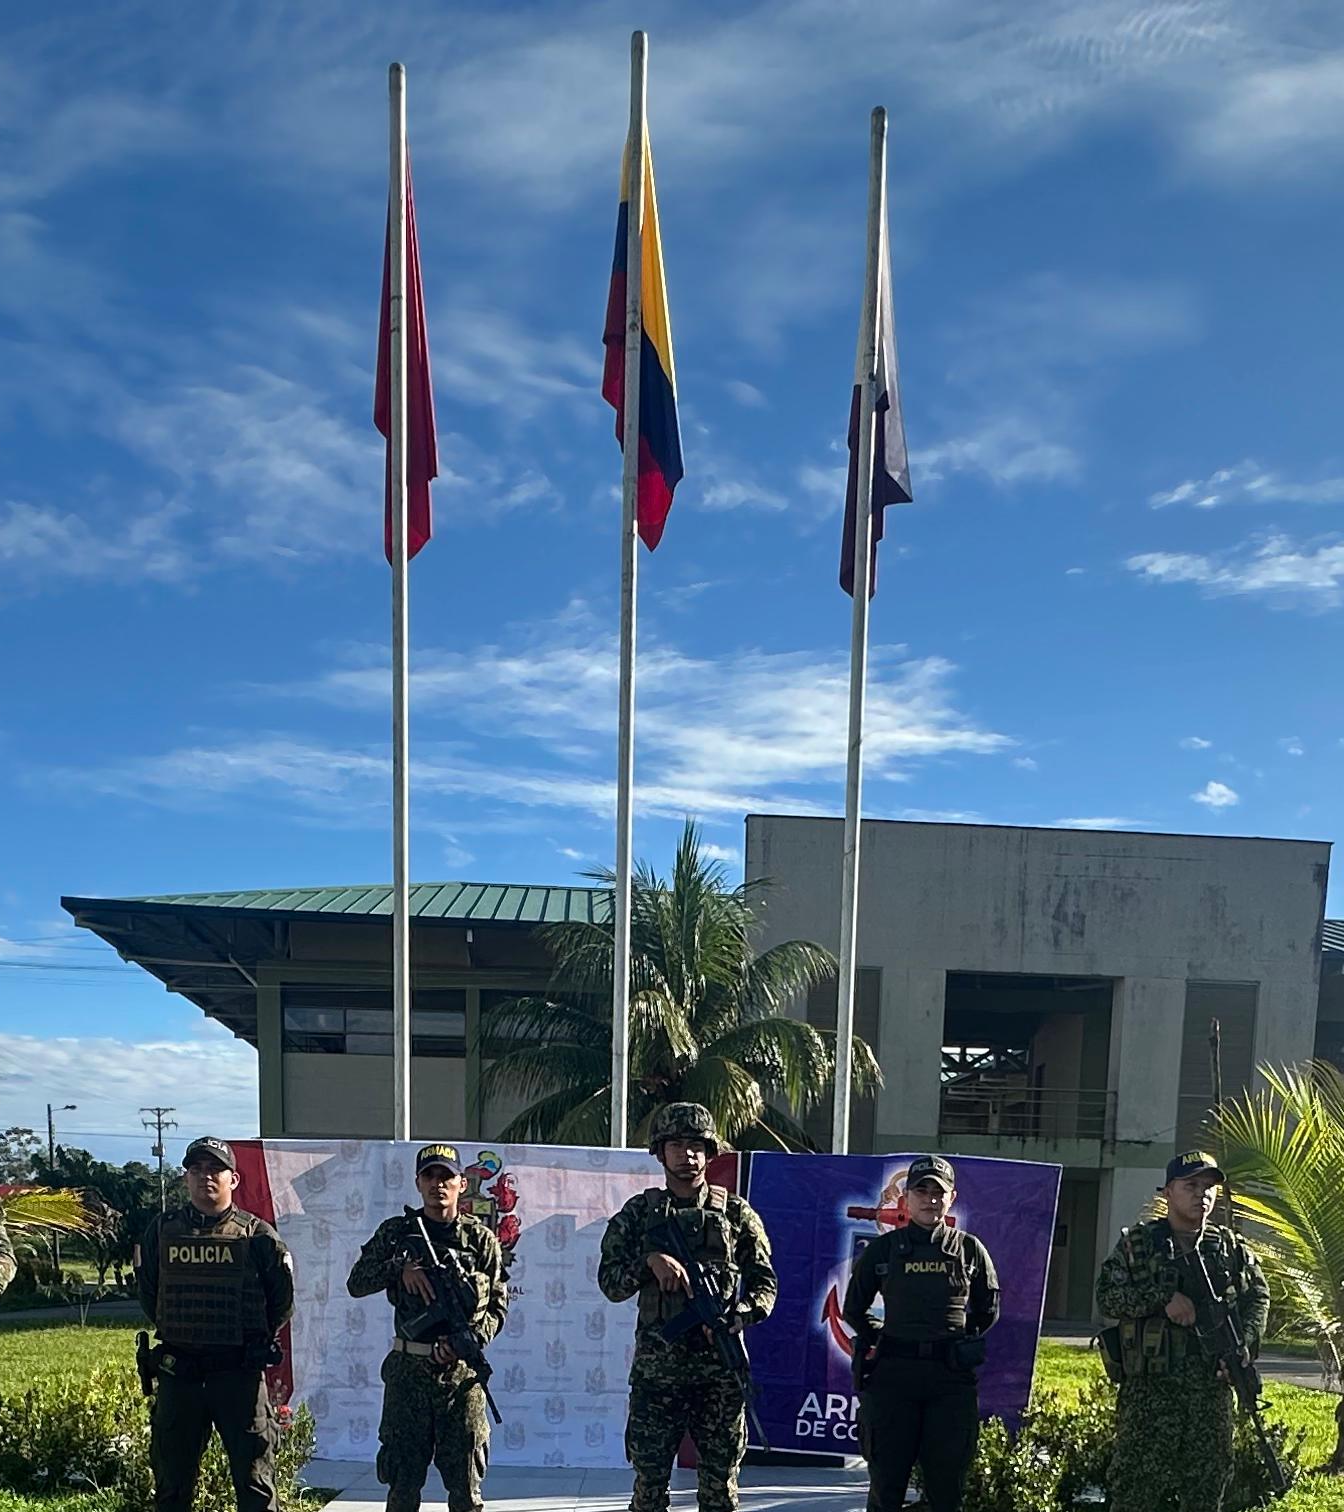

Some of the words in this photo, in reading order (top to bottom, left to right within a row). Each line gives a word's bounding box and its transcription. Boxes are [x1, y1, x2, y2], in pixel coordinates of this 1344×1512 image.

[420, 1145, 456, 1162] ARMADA
[169, 1246, 234, 1263] POLICIA
[905, 1261, 947, 1273] POLICIA
[796, 1418, 827, 1438] DE
